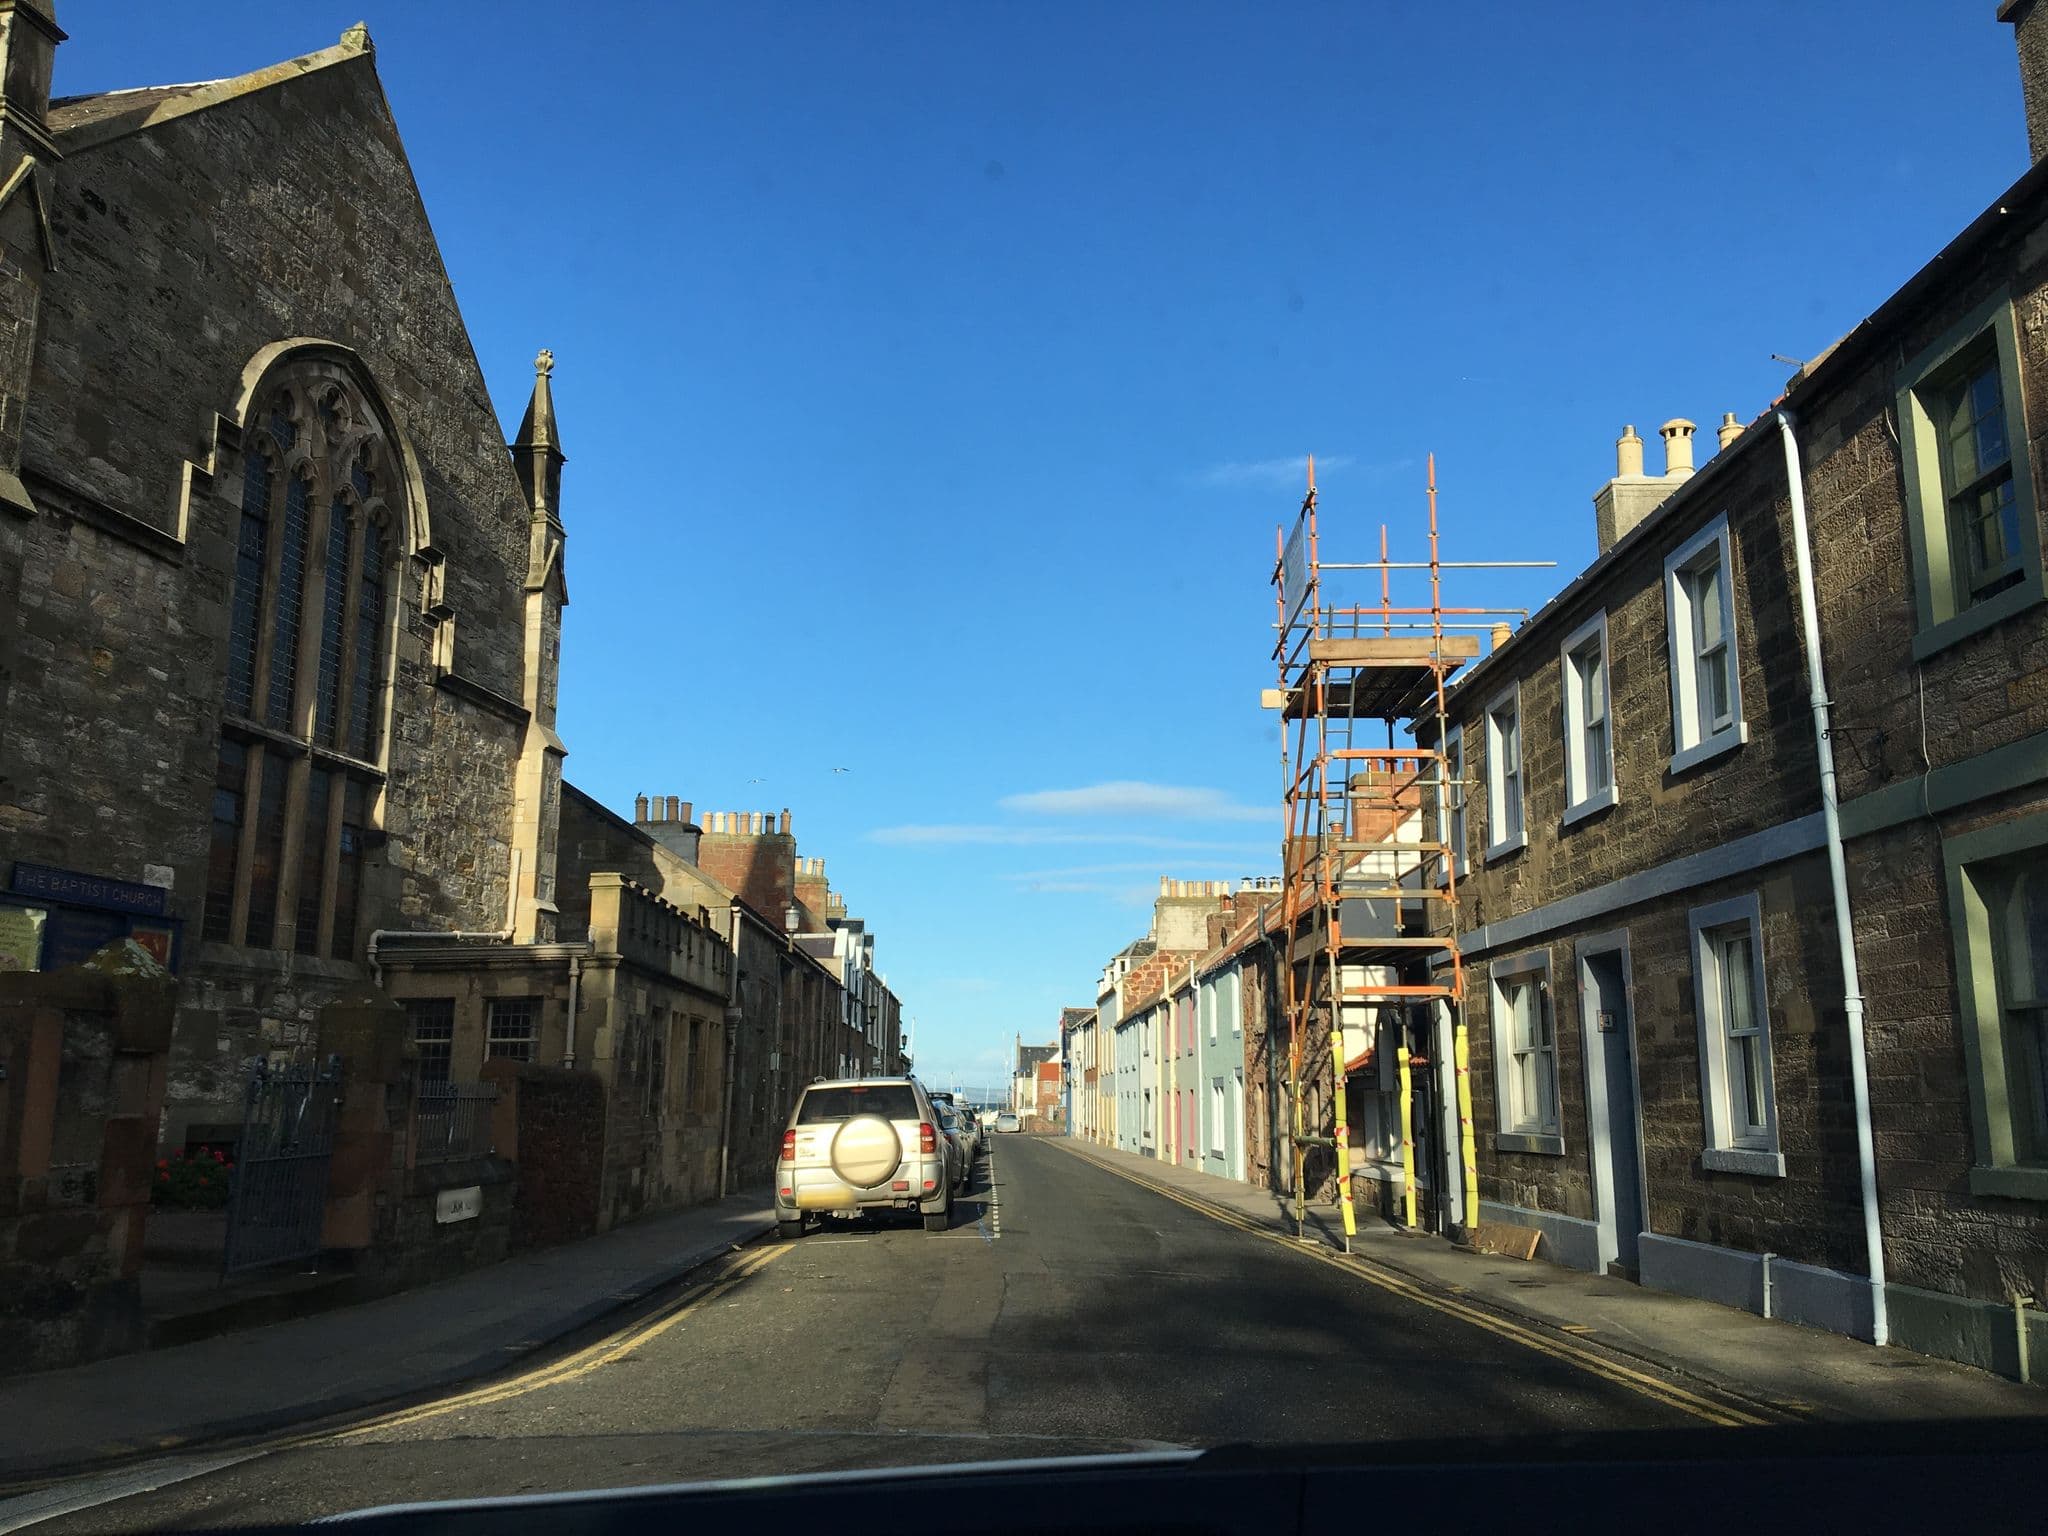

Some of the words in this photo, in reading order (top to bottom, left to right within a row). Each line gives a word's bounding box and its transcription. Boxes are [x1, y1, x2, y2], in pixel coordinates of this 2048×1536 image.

[15, 870, 46, 889] THE
[50, 876, 108, 898] BAPTIST
[112, 888, 161, 907] CHURCH
